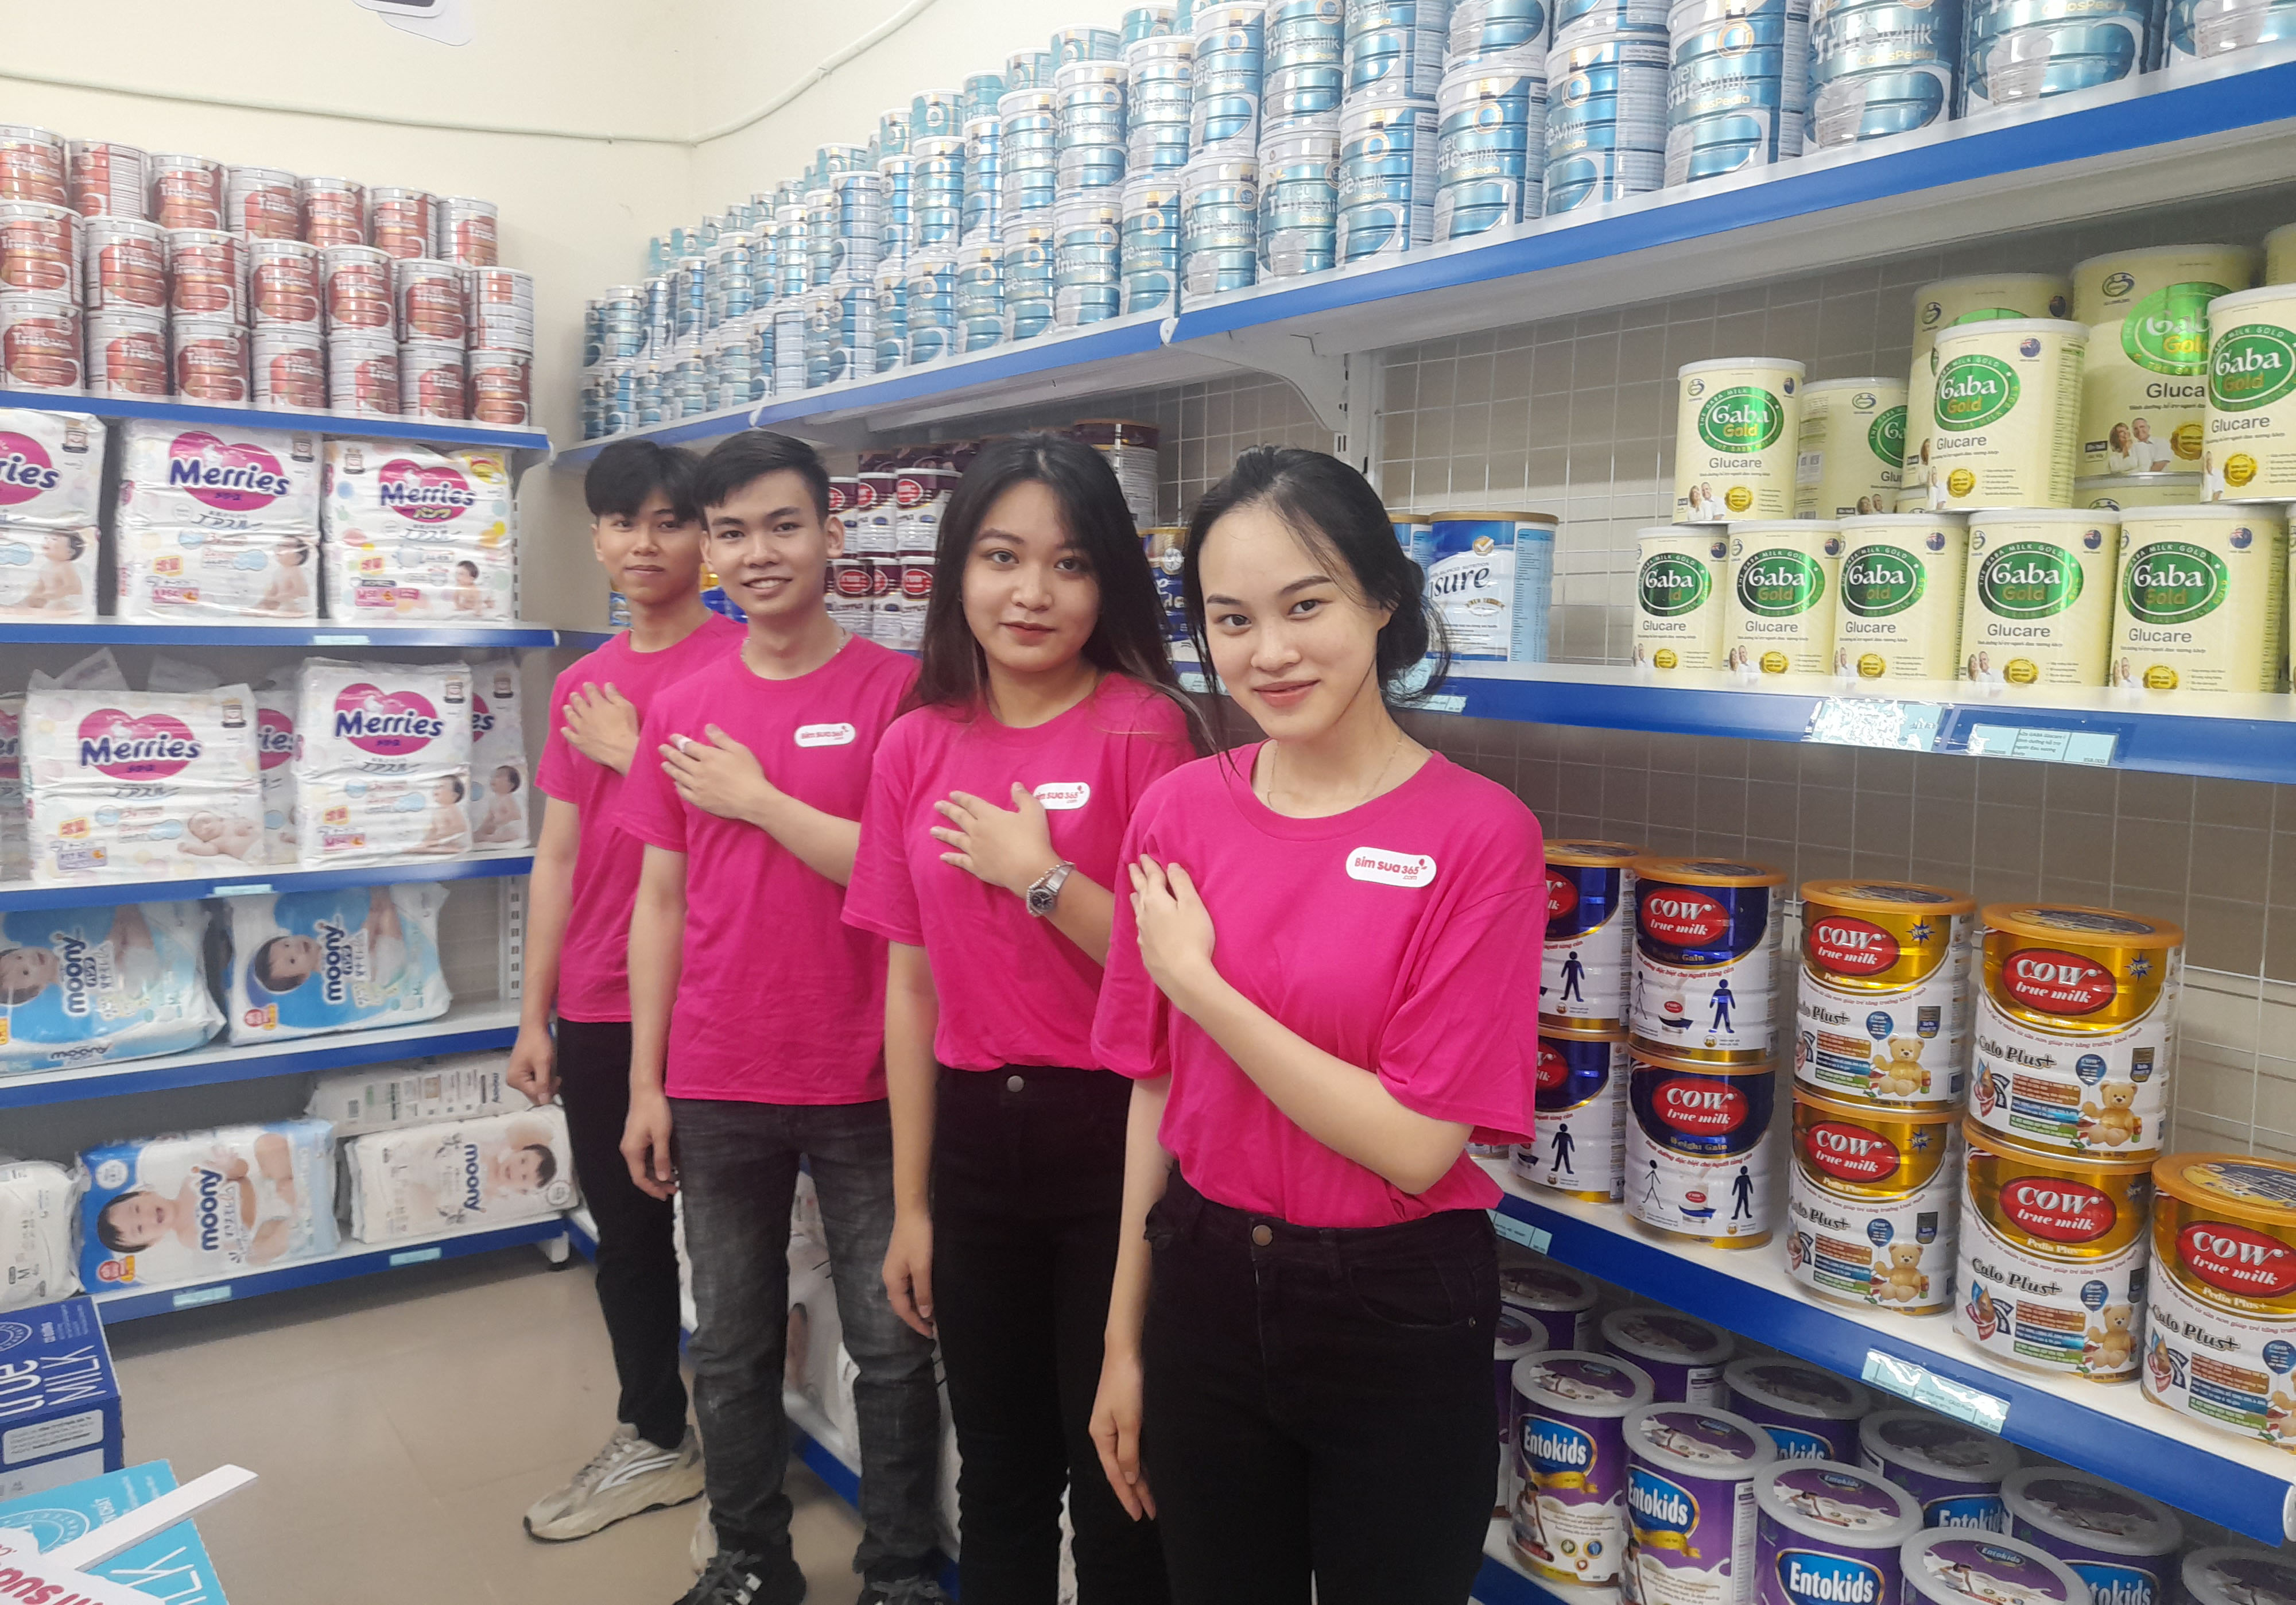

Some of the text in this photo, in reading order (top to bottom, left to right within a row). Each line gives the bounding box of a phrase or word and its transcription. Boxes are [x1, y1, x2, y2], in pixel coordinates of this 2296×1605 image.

[2215, 344, 2283, 377] Gaba
[1940, 376, 1999, 401] Gaba
[2146, 382, 2205, 399] Gluca
[2223, 371, 2264, 391] Gold
[1712, 404, 1770, 425] Gaba
[1947, 398, 1983, 414] Gold
[1723, 422, 1758, 437] Gold
[2211, 414, 2271, 434] Glucare
[1936, 433, 1988, 451] Glucare
[1708, 457, 1763, 469] Glucare
[170, 458, 290, 495] Merries
[379, 482, 476, 506] Merries
[1645, 568, 1694, 590] Gaba
[1748, 565, 1806, 588] Gaba
[1848, 563, 1907, 587] Gaba
[1991, 560, 2062, 586] Gaba
[2133, 560, 2207, 589] Gaba
[1758, 586, 1794, 602] Gold
[2002, 584, 2046, 602] Gold
[2143, 587, 2188, 606] Gold
[1642, 619, 1687, 632] Glucare
[1745, 620, 1799, 634] Glucare
[1845, 621, 1897, 635] Glucare
[1987, 623, 2051, 639] Glucare
[2128, 626, 2193, 645] Glucare
[335, 711, 444, 738] Merries
[80, 734, 200, 767] Merries
[1377, 860, 1401, 874] sua
[1401, 865, 1420, 875] 365
[1650, 897, 1713, 920] COW
[1650, 918, 1709, 936] true milk
[1818, 925, 1886, 951] COW
[325, 924, 345, 1001] moony
[1818, 945, 1878, 966] true milk
[63, 936, 87, 1014] moony
[2016, 958, 2101, 987] COW
[2015, 980, 2092, 1004] true milk
[1812, 1005, 1851, 1025] Plus+
[1979, 1034, 2057, 1069] Calo Plus+
[1666, 1087, 1735, 1110] COW
[1666, 1107, 1732, 1125] true milk
[1816, 1129, 1887, 1157] COW
[1816, 1150, 1879, 1173] true milk
[463, 1144, 481, 1211] moony
[200, 1169, 223, 1251] moony
[2016, 1185, 2103, 1215] COW
[1809, 1205, 1852, 1231] Plus+
[2016, 1208, 2096, 1232] true milk
[2026, 1237, 2054, 1253] Pedia
[2193, 1231, 2289, 1266] COW
[1972, 1257, 2063, 1297] Calo Plus+
[2192, 1254, 2279, 1286] true milk
[2202, 1286, 2232, 1305] Pedia
[2182, 1321, 2241, 1352] Plus+
[40, 1344, 108, 1406] MILK
[1523, 1426, 1587, 1467] Entokids
[1628, 1478, 1689, 1528] Entokids
[1790, 1561, 1875, 1603] Entokids
